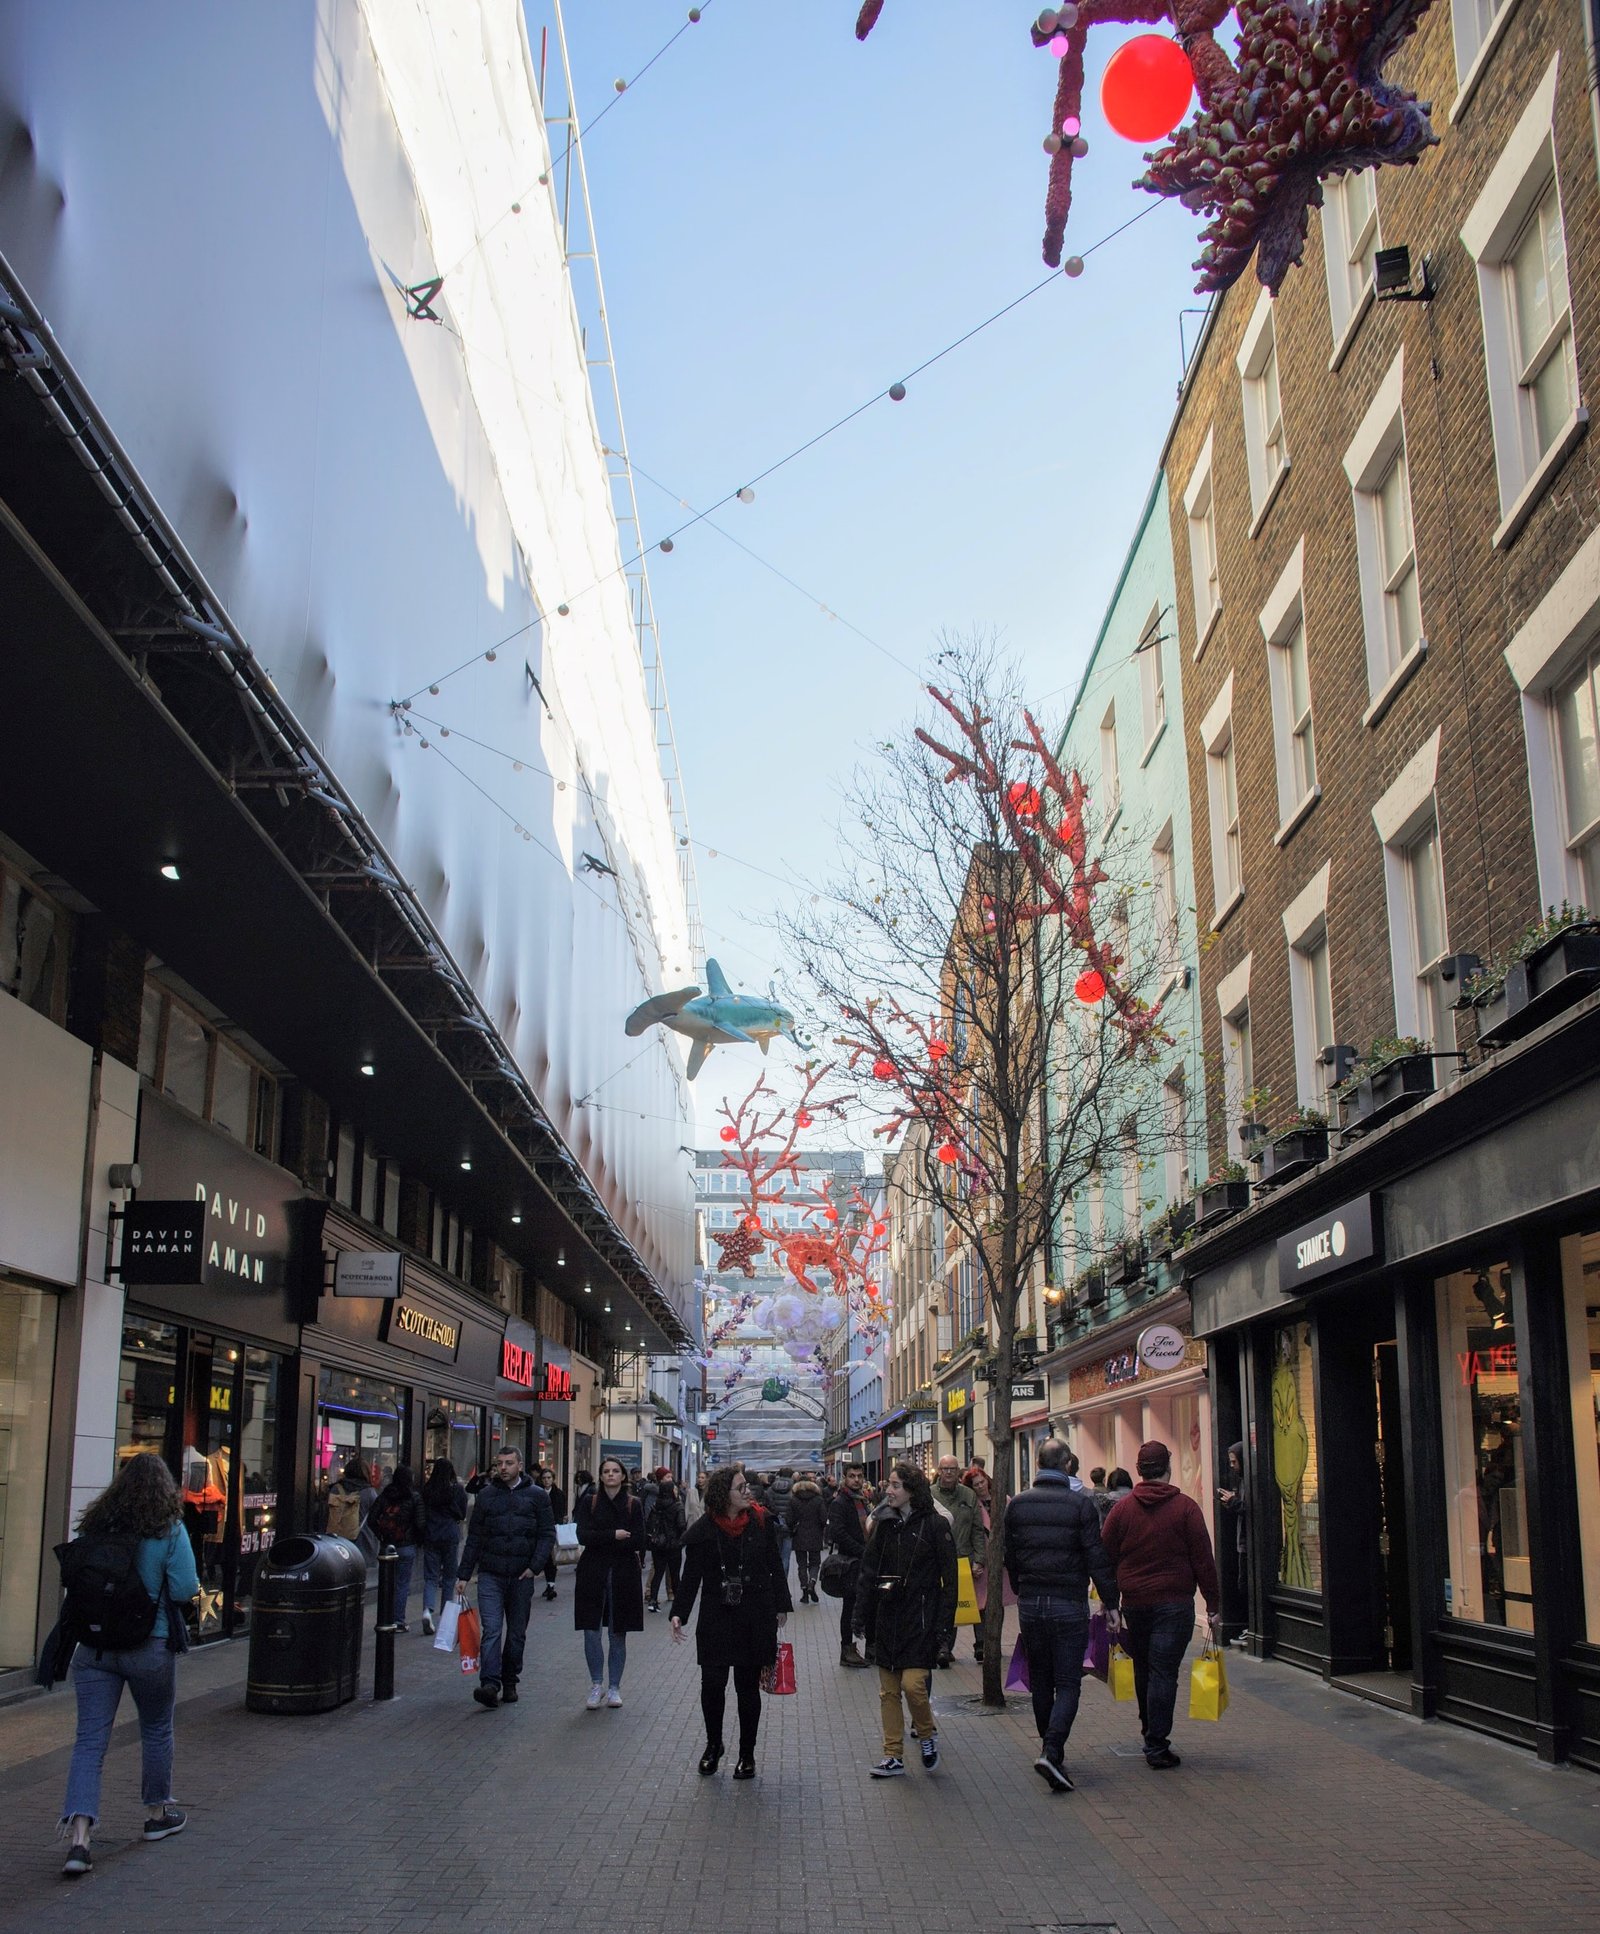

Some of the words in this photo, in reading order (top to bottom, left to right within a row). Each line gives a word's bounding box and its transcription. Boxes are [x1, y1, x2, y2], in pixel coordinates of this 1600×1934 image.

[195, 1182, 266, 1238] DAVID
[132, 1230, 193, 1239] DAVID
[131, 1244, 192, 1253] NAMAN
[1297, 1229, 1331, 1270] STANCE
[208, 1240, 264, 1284] AMAN
[1152, 1335, 1175, 1347] Too
[1143, 1345, 1184, 1358] Faced
[503, 1339, 535, 1388] REPLAY
[538, 1391, 574, 1400] REPLAY
[1011, 1385, 1035, 1397] ANS
